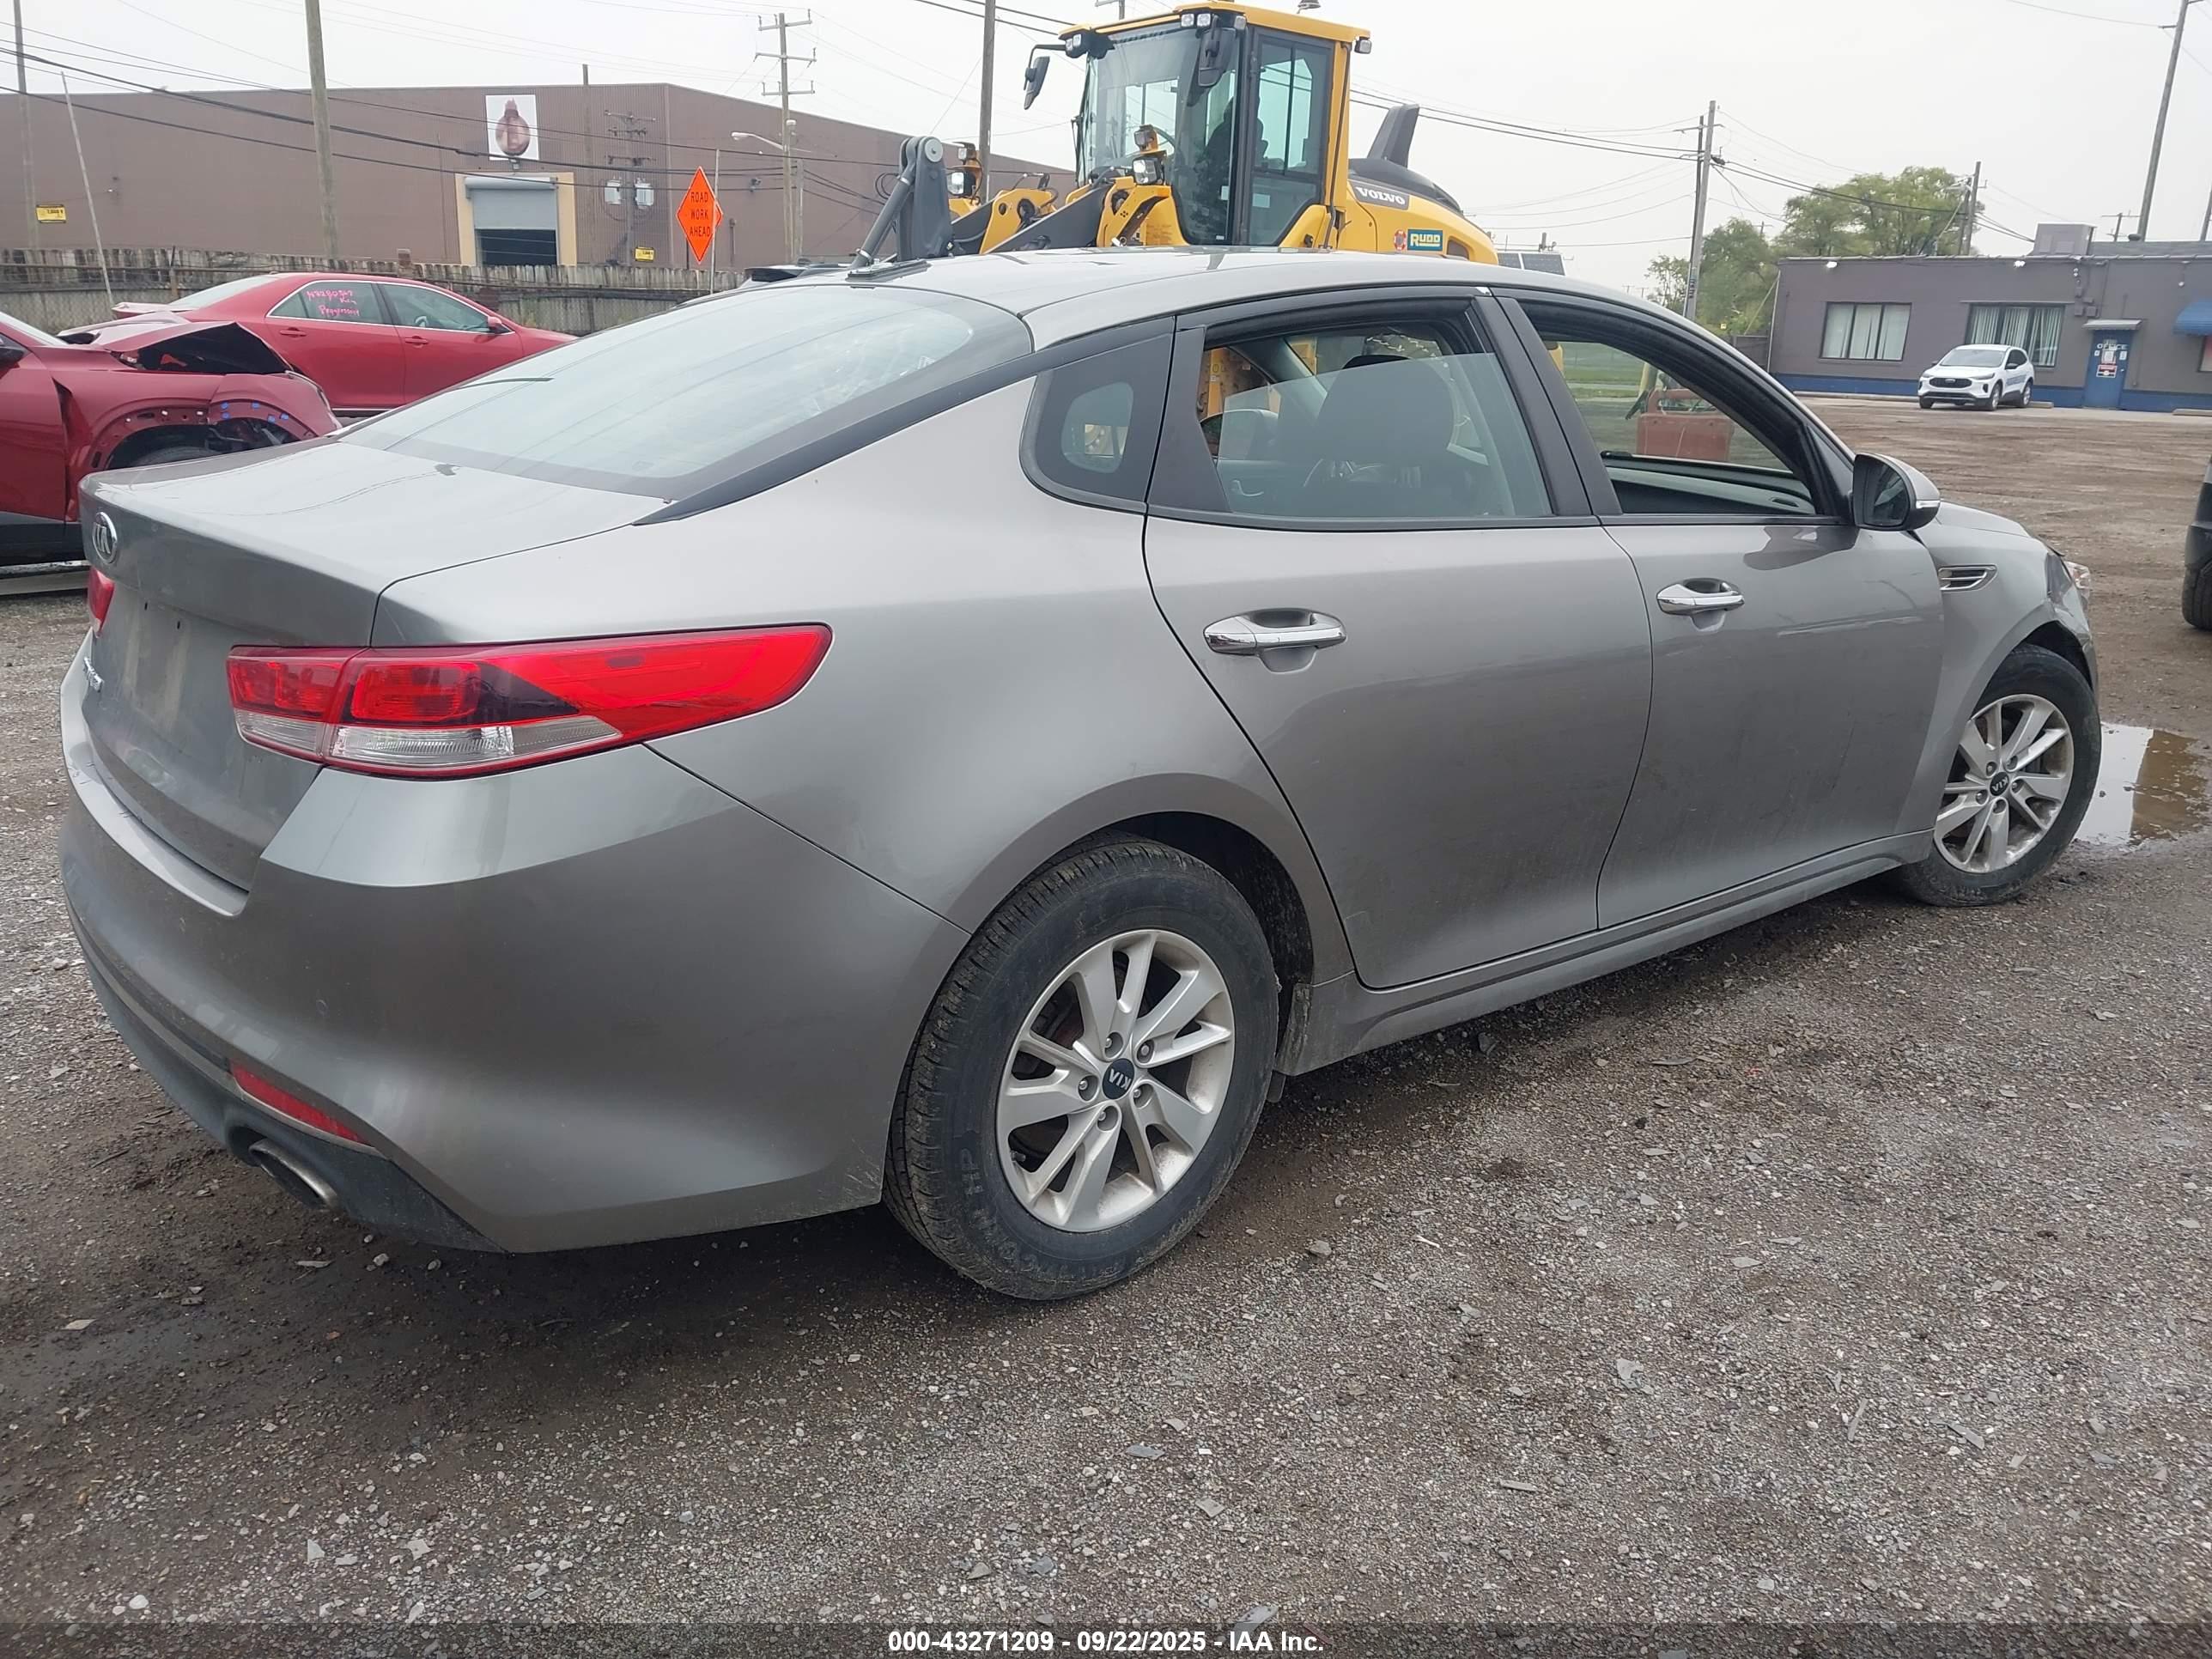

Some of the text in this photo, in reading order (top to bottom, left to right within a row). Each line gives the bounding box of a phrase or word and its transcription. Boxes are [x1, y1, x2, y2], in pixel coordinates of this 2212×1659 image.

[690, 191, 708, 203] ROAD
[1355, 186, 1406, 205] VOLVO
[690, 210, 708, 220] WORK
[690, 226, 711, 237] AHEAD
[1410, 233, 1441, 247] RUDD
[94, 521, 111, 555] IA
[1991, 775, 2008, 792] KIA
[1109, 1068, 1132, 1091] KIA
